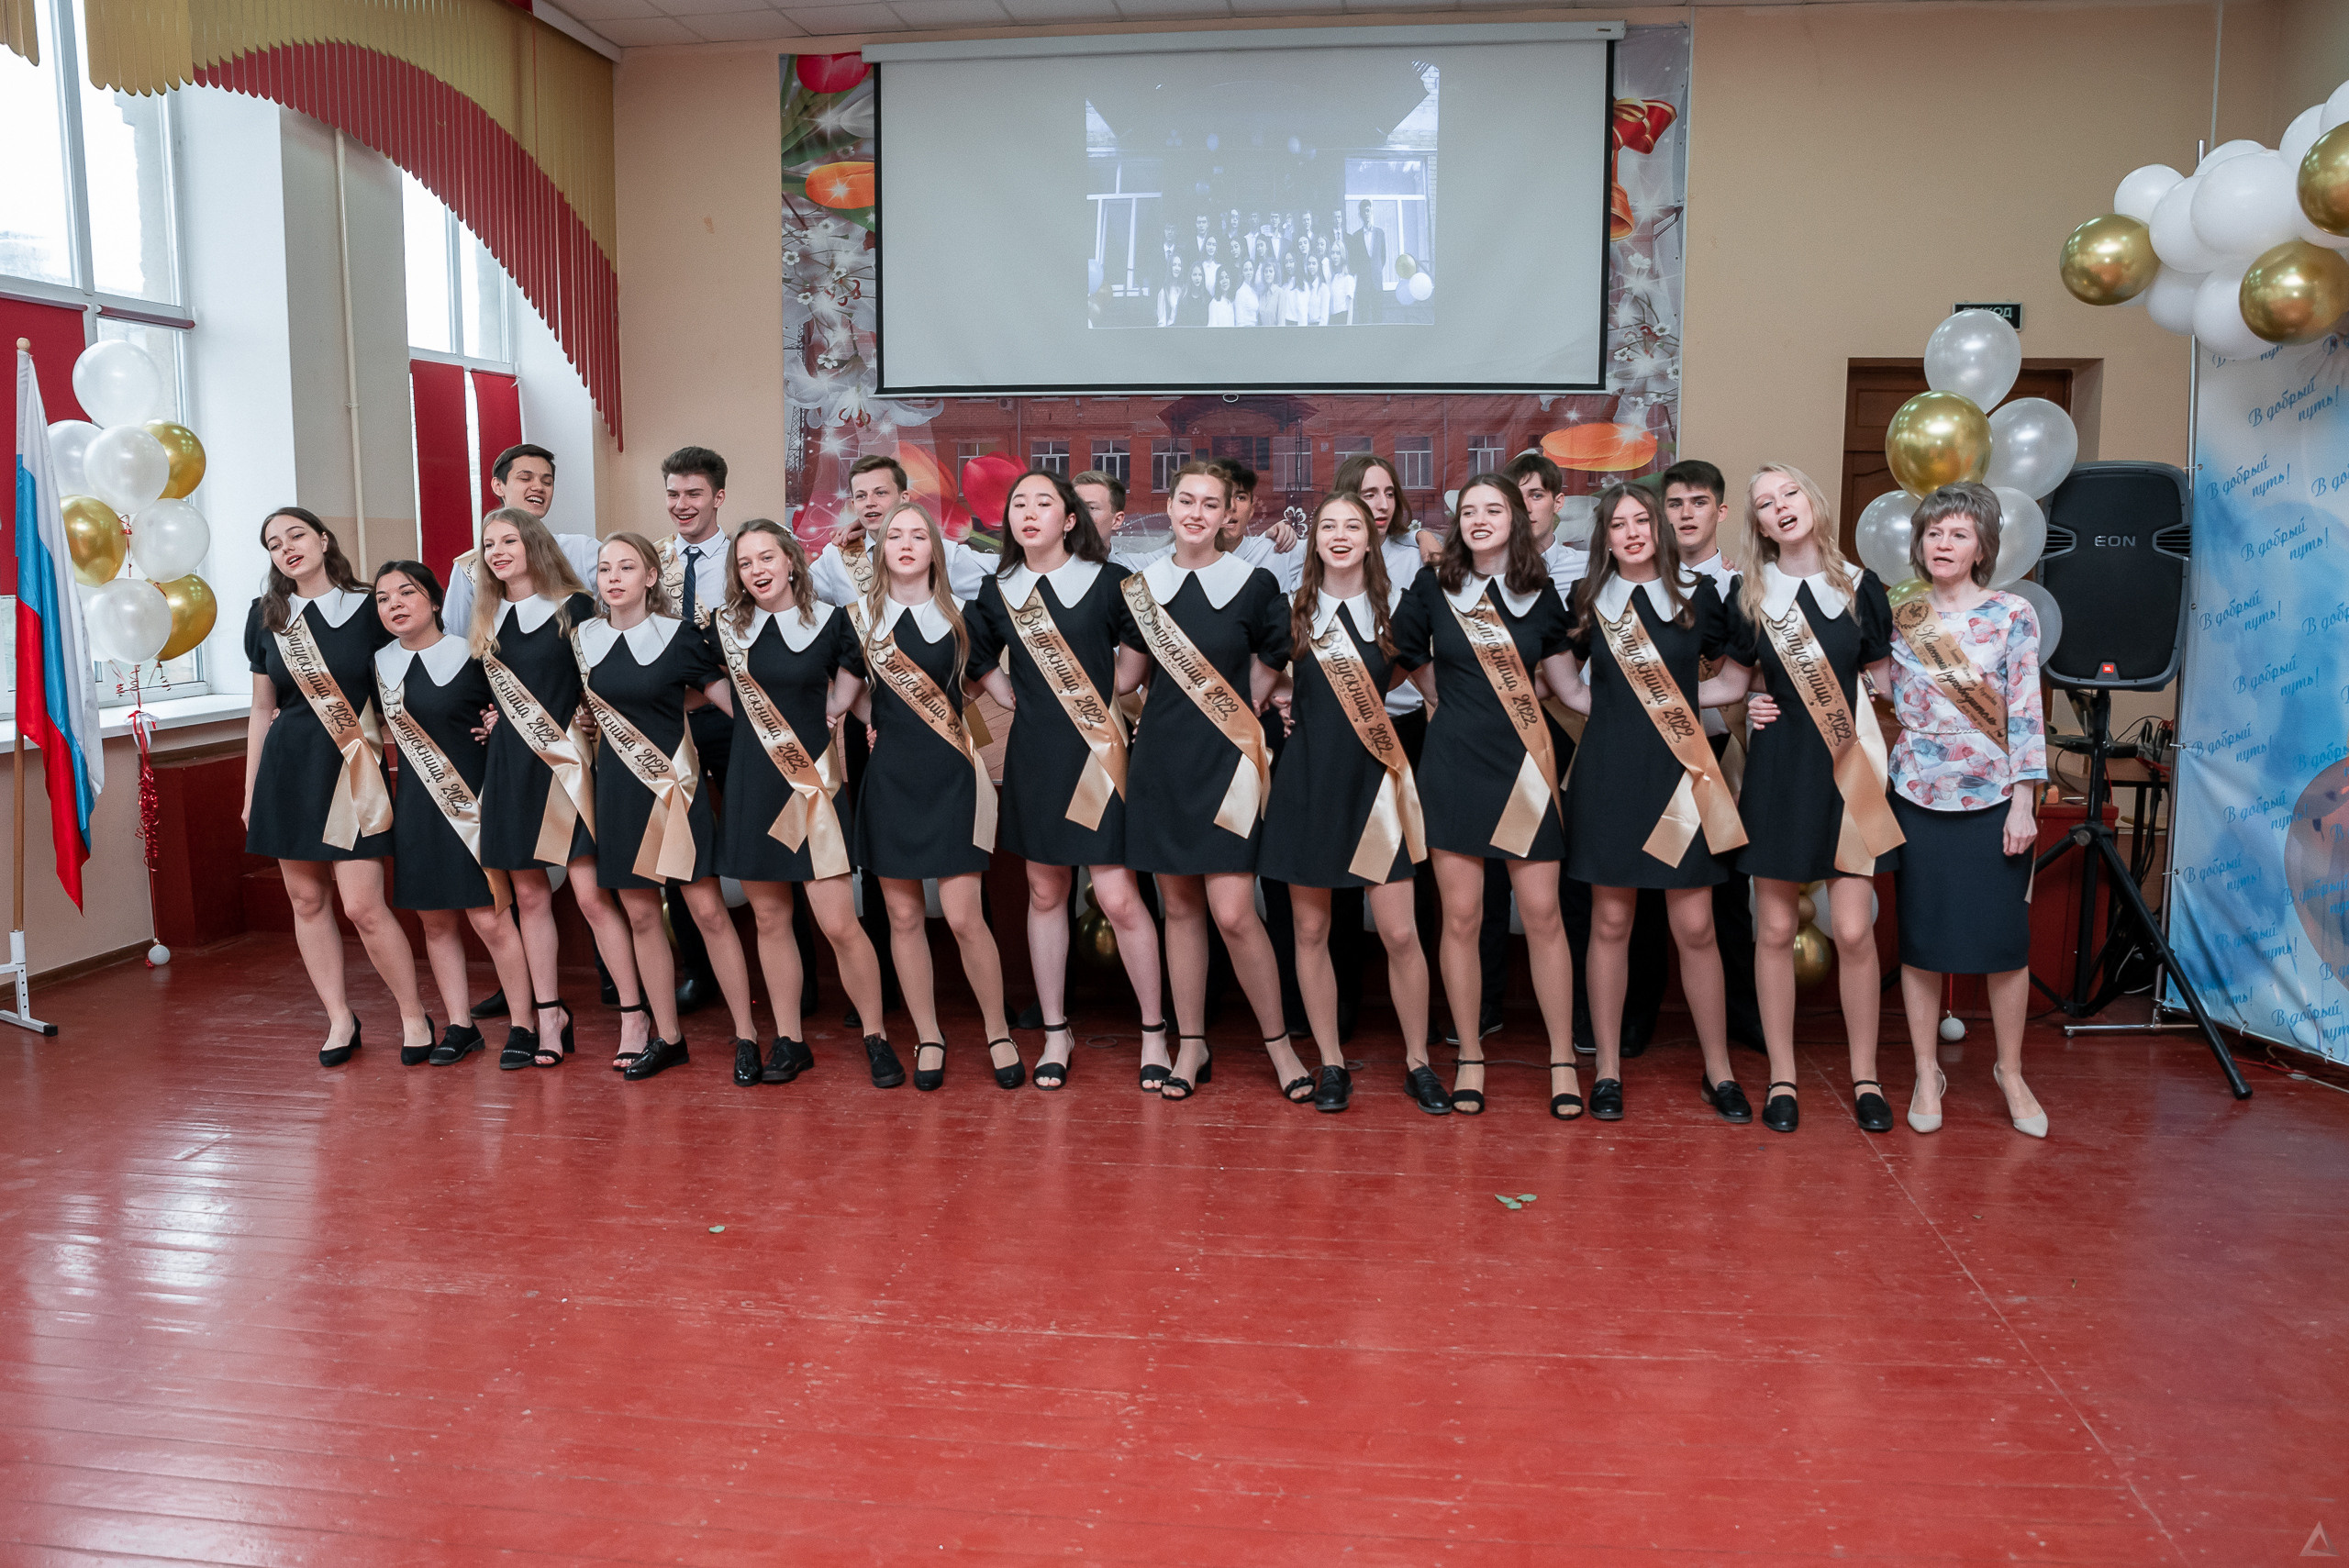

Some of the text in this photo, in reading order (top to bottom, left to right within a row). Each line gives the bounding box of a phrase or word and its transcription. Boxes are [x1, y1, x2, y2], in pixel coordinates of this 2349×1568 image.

[2248, 375, 2316, 427] В добрый
[2298, 384, 2339, 421] путь!
[2206, 453, 2270, 500] В добрый
[2252, 463, 2290, 497] путь!
[2311, 477, 2327, 496] В
[2094, 535, 2136, 547] EON
[2241, 517, 2308, 562] В добрый
[2289, 527, 2329, 561] путь!
[2199, 590, 2262, 631] В добрый
[2244, 600, 2282, 631] путь!
[2301, 617, 2316, 636] В
[1019, 596, 1080, 695] Выпускница
[1074, 695, 1107, 728] 2022
[1133, 595, 1207, 689] Выпускница
[1204, 685, 1239, 718] 2022
[1915, 624, 1951, 672] Классный
[870, 635, 948, 721] Выпускница
[1318, 619, 1374, 723] Выпускница
[1368, 723, 1395, 757] 2022
[1608, 610, 1669, 706] Выпускница
[1663, 706, 1695, 740] 2022
[1772, 608, 1832, 707] Выпускница
[1825, 708, 1852, 743] 2022
[2233, 653, 2298, 695] В добрый
[2280, 666, 2319, 697] путь!
[326, 701, 357, 732] 2022
[482, 659, 530, 719] пускница
[526, 717, 560, 748] 2022
[725, 637, 782, 740] Выпускница
[776, 741, 809, 773] 2022
[1512, 694, 1538, 728] 2022
[584, 688, 636, 752] ускница
[634, 748, 670, 778] 2022
[2191, 722, 2252, 759] В добрый
[2235, 735, 2272, 763] путь!
[383, 690, 446, 784] Выпускница
[440, 783, 473, 816] 2022
[2293, 754, 2307, 773] В
[2223, 789, 2288, 825] В добрый
[2271, 803, 2308, 831] путь!
[2330, 823, 2344, 843] В
[2184, 852, 2242, 884] В добрый
[2226, 866, 2262, 892] путь!
[2320, 962, 2333, 981] В
[2271, 1008, 2285, 1027] В
